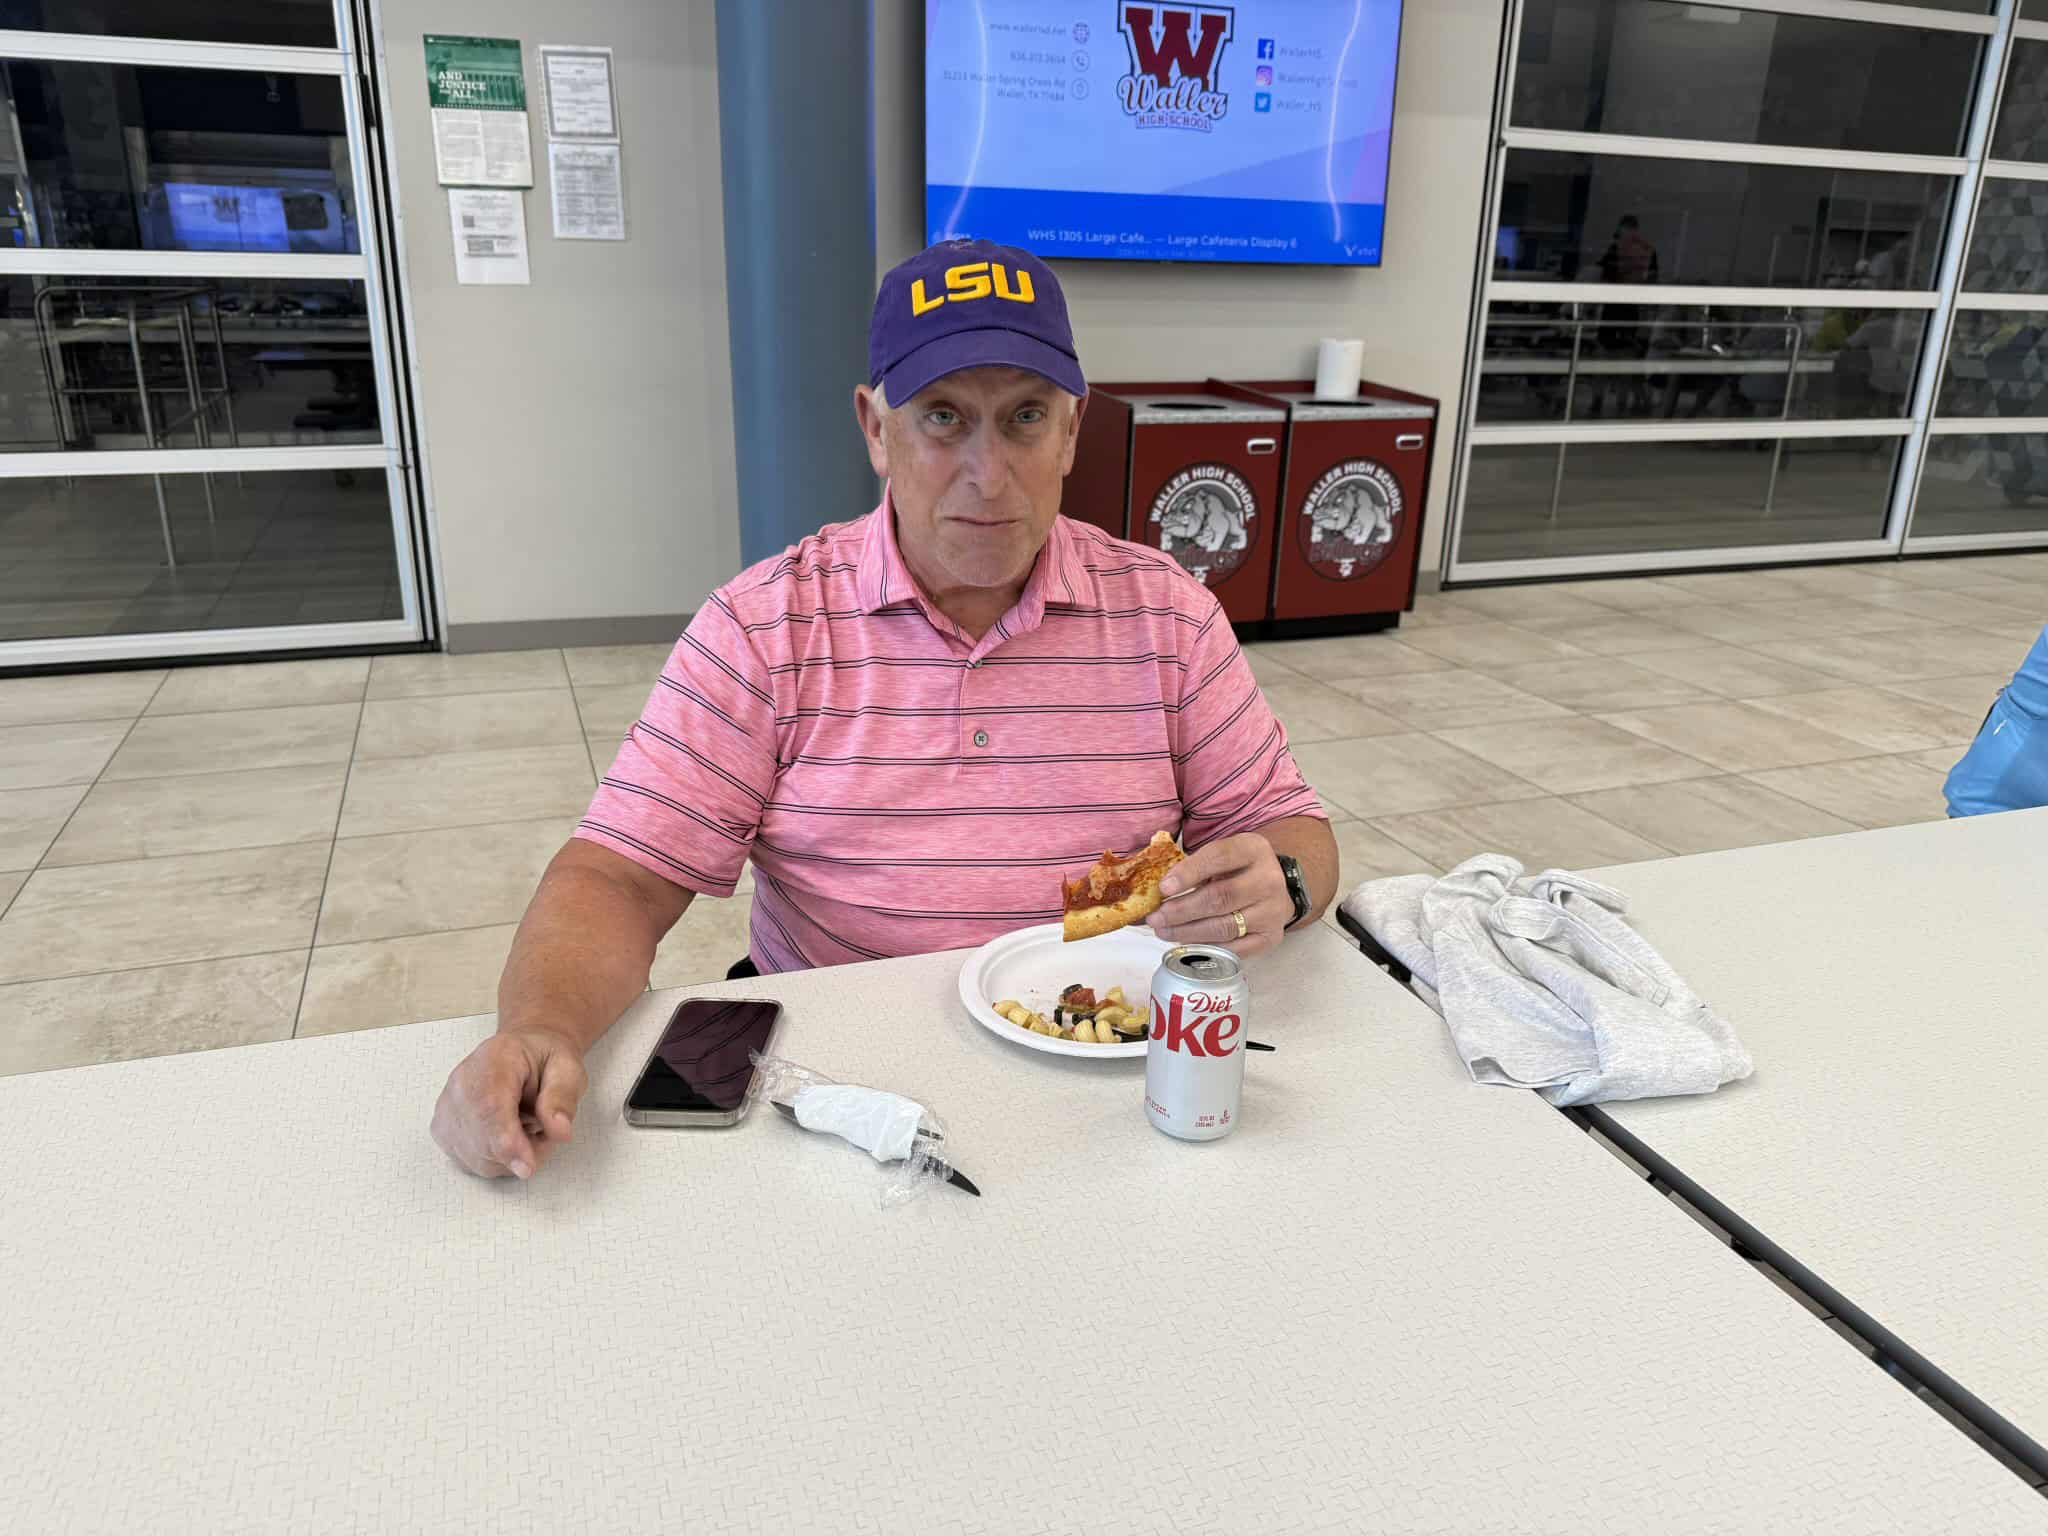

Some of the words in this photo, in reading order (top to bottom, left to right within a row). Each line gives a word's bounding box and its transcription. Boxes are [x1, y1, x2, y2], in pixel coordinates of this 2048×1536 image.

[1118, 2, 1234, 92] W
[438, 71, 463, 81] AND
[438, 80, 488, 91] JUSTICE
[453, 89, 473, 99] ALL
[1117, 74, 1229, 120] Waller
[1137, 112, 1165, 127] HIGH
[1167, 113, 1211, 130] SCHOOL
[1027, 229, 1056, 242] WHS
[1085, 231, 1117, 246] Large
[1168, 233, 1199, 248] Large
[1201, 234, 1248, 248] Cafeteria
[1251, 236, 1288, 250] Display
[911, 262, 1035, 317] LSU
[1150, 473, 1191, 522] WALLER
[1191, 466, 1225, 480] HIGH
[1225, 473, 1256, 522] SCHOOL
[1302, 467, 1343, 515] WALLER
[1344, 461, 1376, 476] HIGH
[1375, 466, 1402, 516] SCHOOL
[1187, 991, 1233, 1014] Diet
